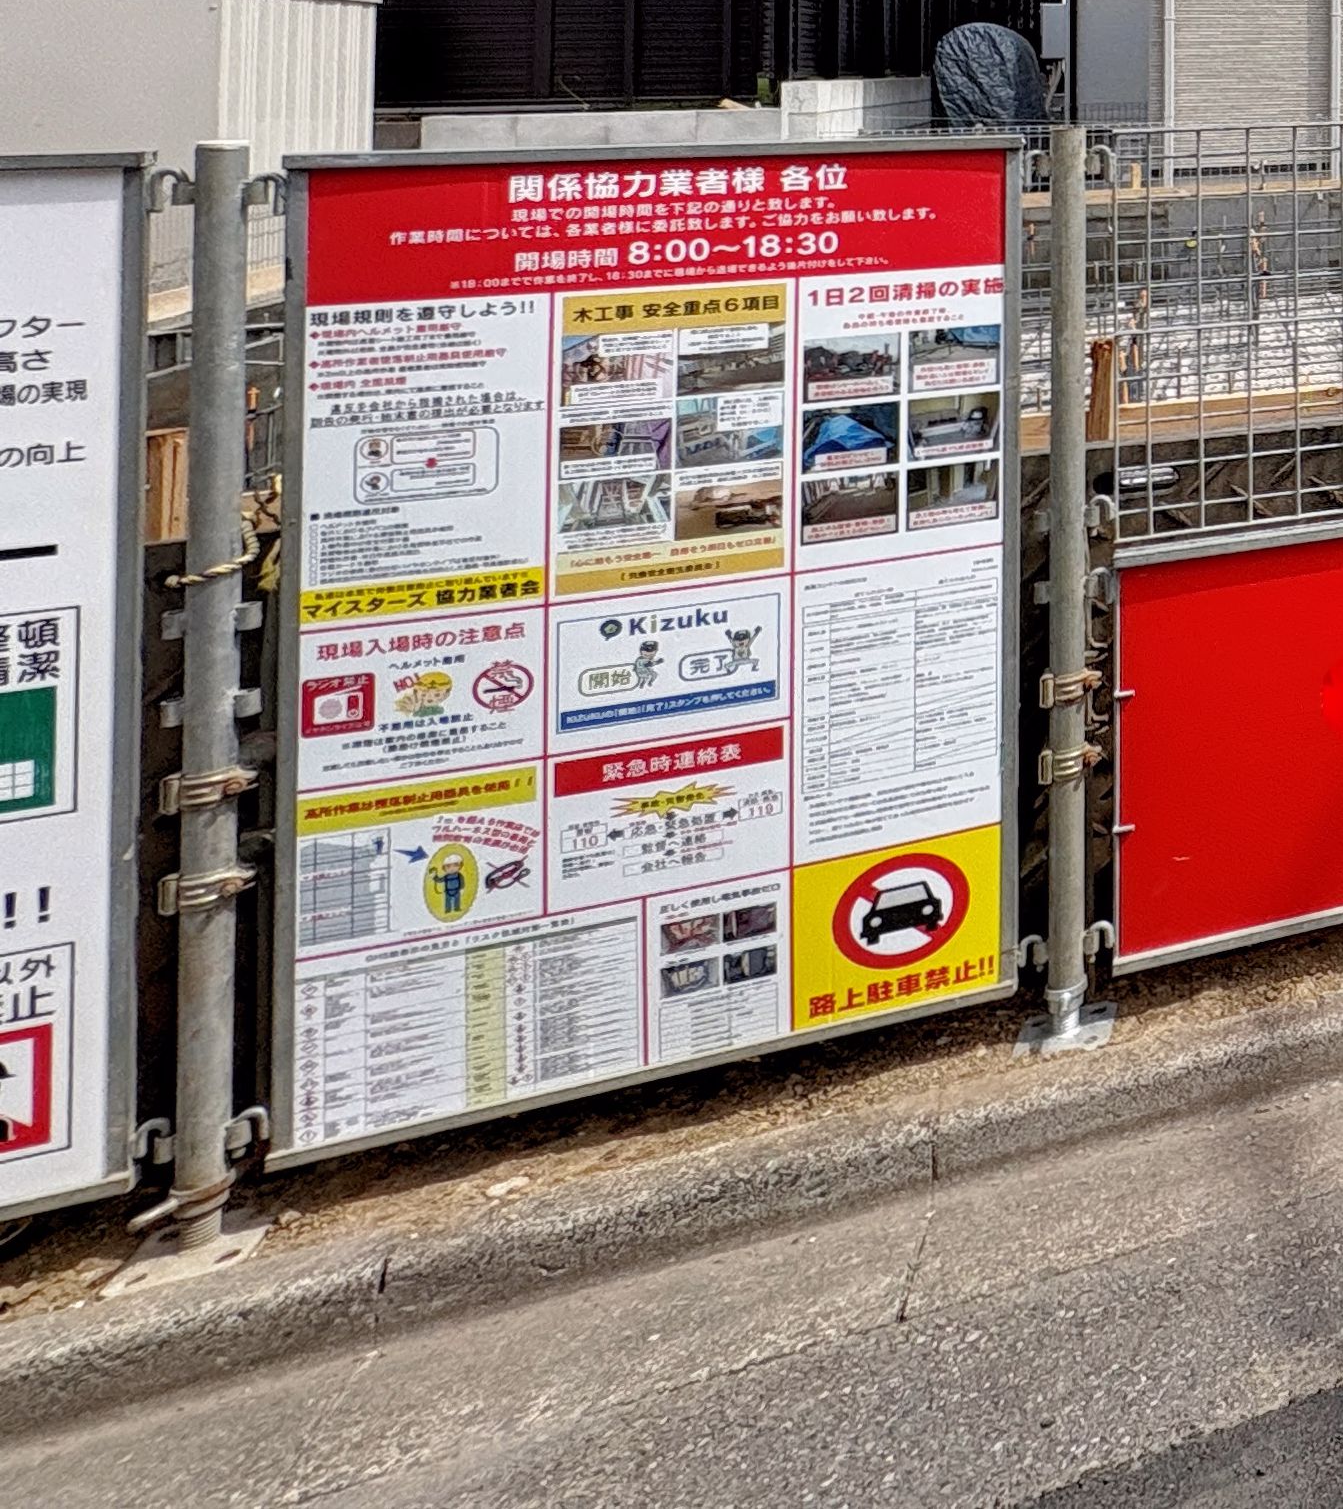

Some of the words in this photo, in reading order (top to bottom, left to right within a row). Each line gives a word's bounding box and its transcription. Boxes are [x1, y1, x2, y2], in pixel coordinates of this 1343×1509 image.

[507, 166, 765, 203] 関係協力業者様
[779, 162, 847, 193] 各位
[514, 247, 618, 272] 開場時間
[806, 276, 1003, 307] 1日2回清掃の実施
[572, 303, 633, 324] 木工事
[642, 294, 779, 319] 安全重点6項目
[302, 590, 427, 621] マイスターズ
[435, 578, 540, 605] 協力業者会
[0, 617, 62, 651] 頓
[628, 605, 729, 635] Kizuku
[316, 620, 526, 663] 現場入場時の注意点
[0, 649, 61, 686] 潔
[587, 667, 633, 691] 開始
[689, 653, 726, 676] 完了
[602, 742, 742, 781] 緊急時連絡表
[748, 803, 774, 818] 119
[571, 834, 599, 851] 110
[808, 956, 995, 1019] 路上駐車禁止!!
